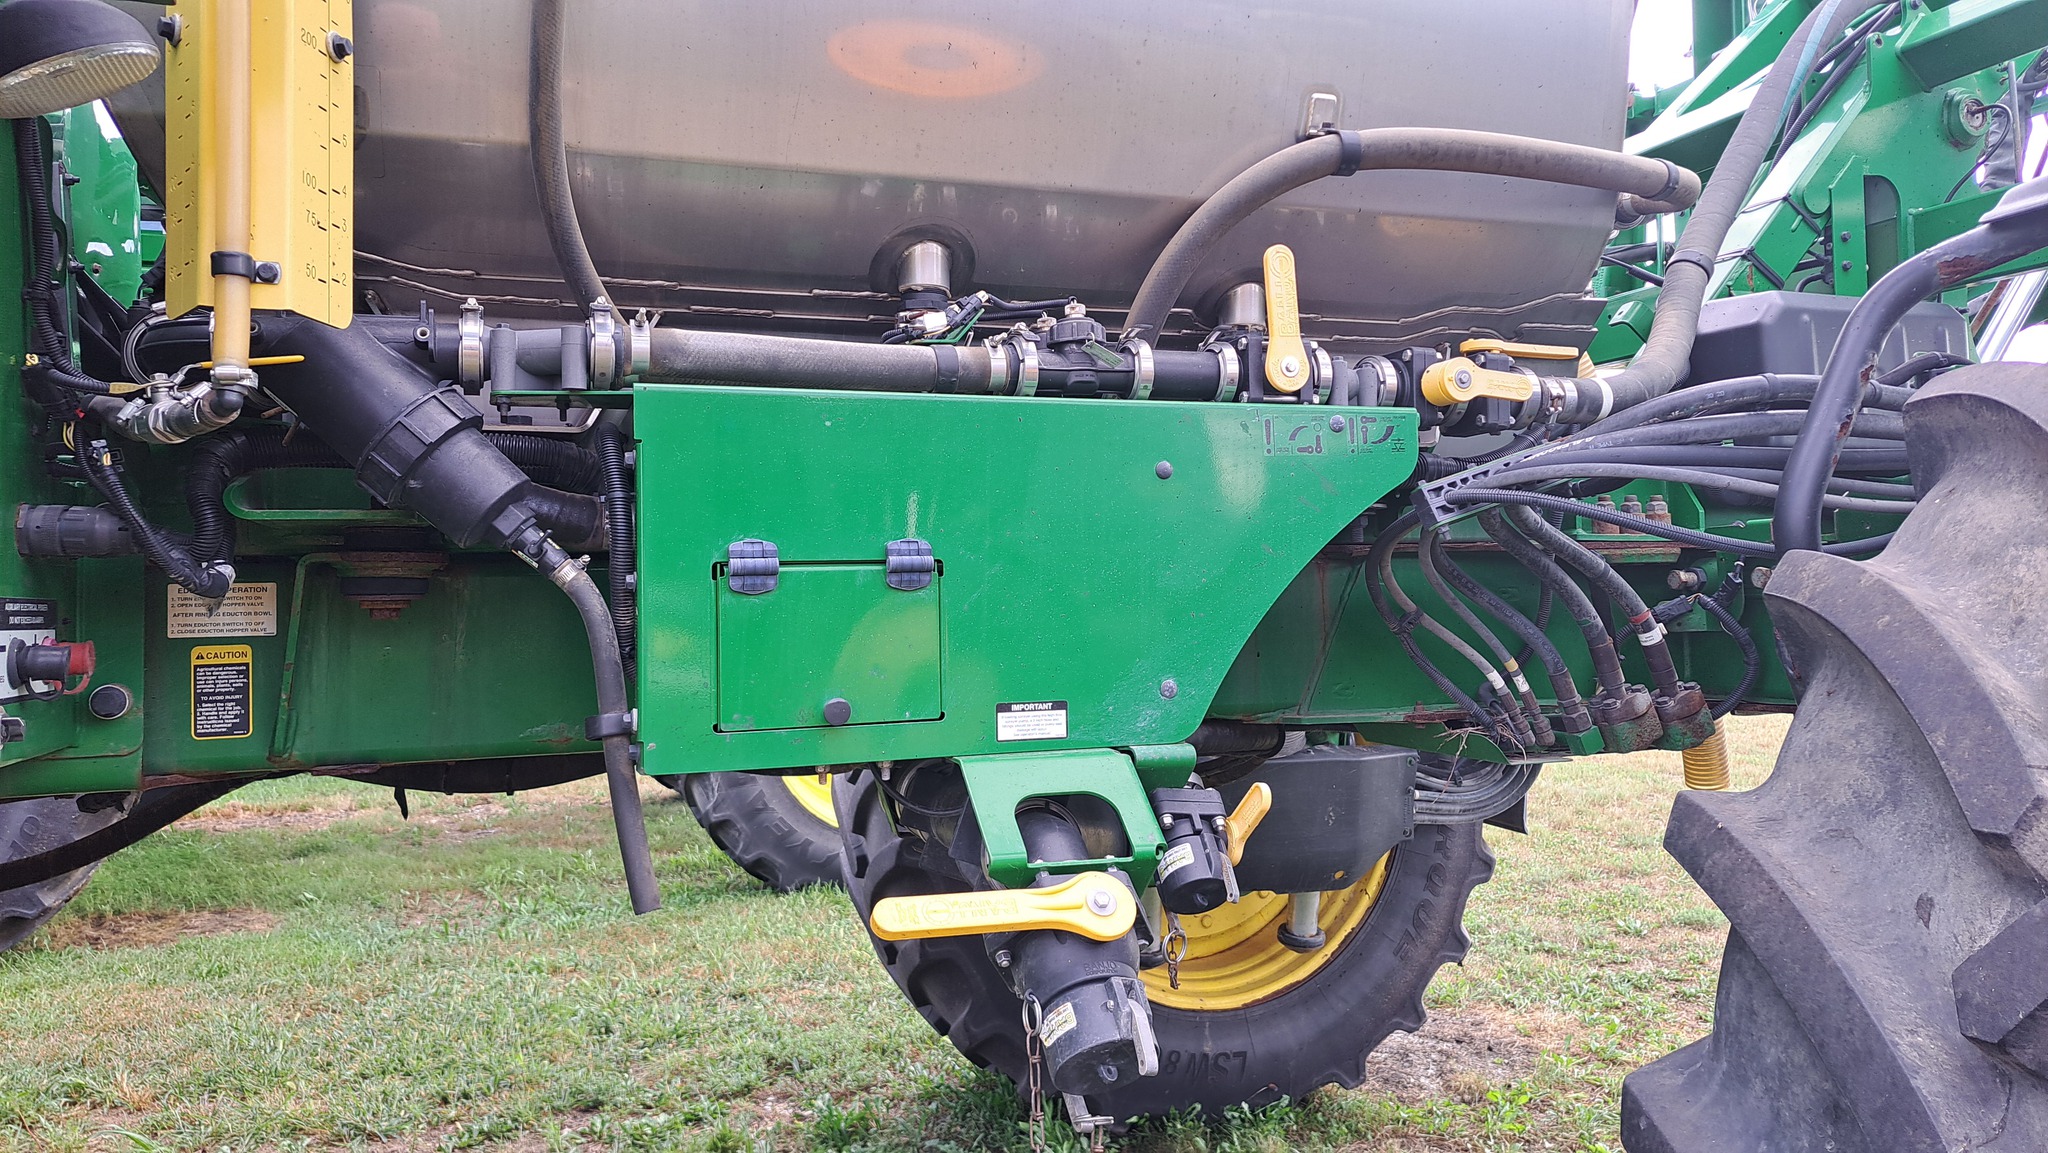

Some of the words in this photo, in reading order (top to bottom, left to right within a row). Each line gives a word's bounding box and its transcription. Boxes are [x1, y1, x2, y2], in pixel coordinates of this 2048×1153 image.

[300, 28, 318, 50] 200
[342, 134, 348, 148] 5
[302, 170, 316, 190] 100
[342, 185, 347, 198] 4
[306, 208, 316, 226] 75
[341, 218, 348, 232] 3
[305, 263, 316, 280] 50
[341, 273, 348, 286] 2
[206, 651, 248, 659] CAUTION
[1012, 702, 1053, 711] IMPORTANT
[1084, 960, 1117, 972] BANJO
